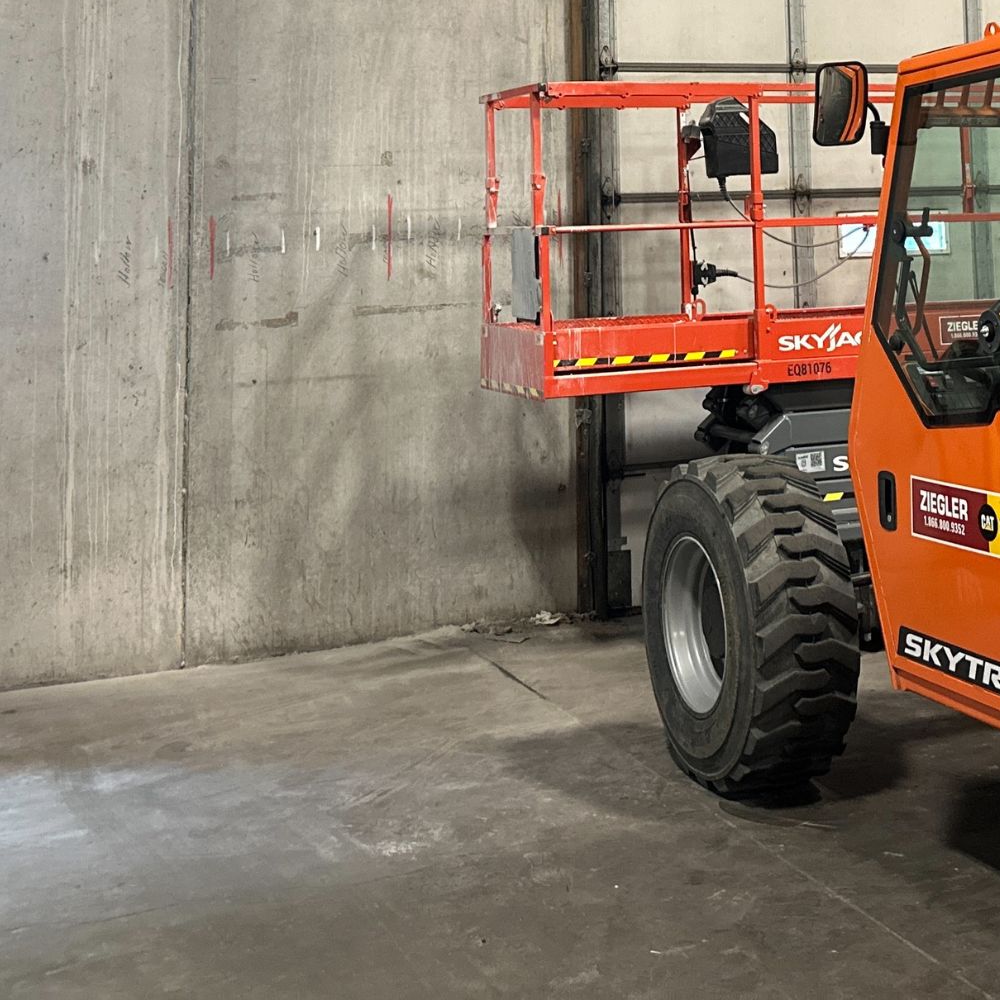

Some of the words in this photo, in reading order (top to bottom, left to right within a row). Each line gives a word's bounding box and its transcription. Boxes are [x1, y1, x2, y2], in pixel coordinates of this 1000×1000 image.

[947, 320, 979, 332] ZIEGLE
[778, 322, 863, 352] SKYJA
[919, 489, 968, 521] ZIEGLER
[923, 515, 966, 536] 1.866.800.9352
[981, 514, 994, 532] CAT
